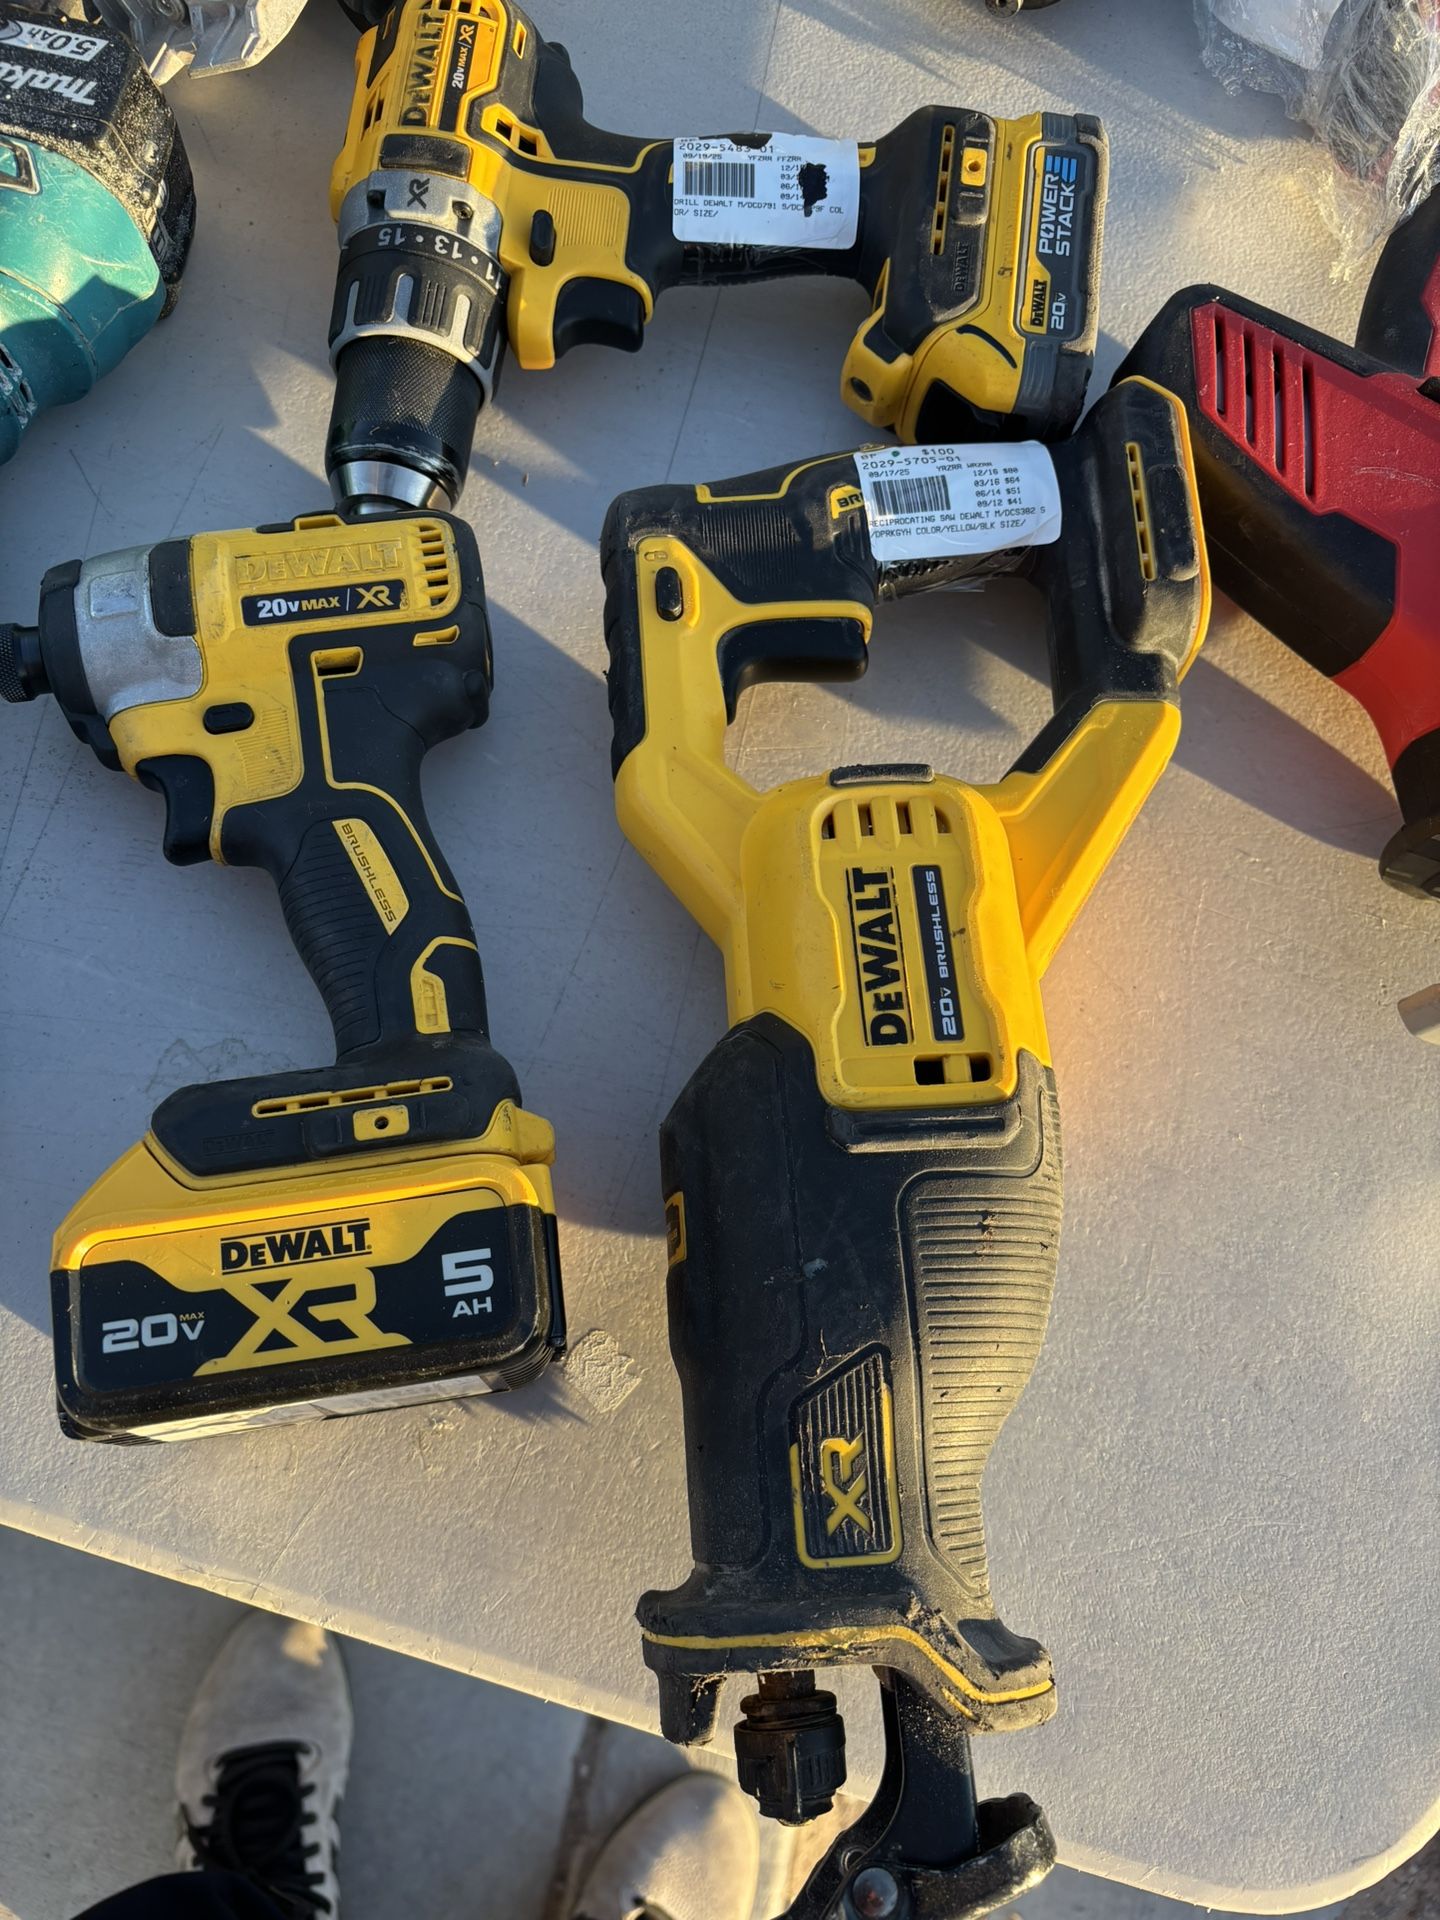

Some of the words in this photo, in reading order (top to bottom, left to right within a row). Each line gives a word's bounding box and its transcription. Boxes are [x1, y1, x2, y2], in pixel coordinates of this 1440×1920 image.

[459, 23, 476, 44] XR
[407, 177, 431, 209] XR
[703, 200, 733, 208] DEWALT
[693, 209, 719, 217] SIZE/
[1038, 173, 1060, 254] POWER
[1055, 183, 1076, 256] STACK
[377, 227, 407, 248] 15
[433, 234, 463, 260] 13
[1030, 279, 1047, 327] DEWALT
[862, 456, 961, 470] 2029-5705-01
[921, 448, 954, 456] $100
[868, 469, 910, 478] 09/17/25
[973, 468, 998, 477] 12/16
[1005, 476, 1021, 485] $64
[1006, 487, 1022, 495] $51
[1007, 497, 1022, 505] $41
[869, 515, 936, 528] RECIPROCATING
[940, 513, 956, 522] SAW
[960, 510, 990, 521] DEWALT
[1000, 518, 1027, 528] SIZE/
[237, 542, 403, 583] DEWALT
[301, 596, 341, 612] MAX
[356, 585, 394, 610] XR
[340, 822, 397, 923] BRUSHLESS
[925, 870, 950, 979] BRUSHLESS
[850, 866, 911, 1047] DEWALT
[221, 1221, 372, 1272] DEWALT
[441, 1247, 495, 1297] 5
[179, 1311, 205, 1322] MAX
[192, 1267, 414, 1377] XR
[820, 1432, 871, 1537] XR
